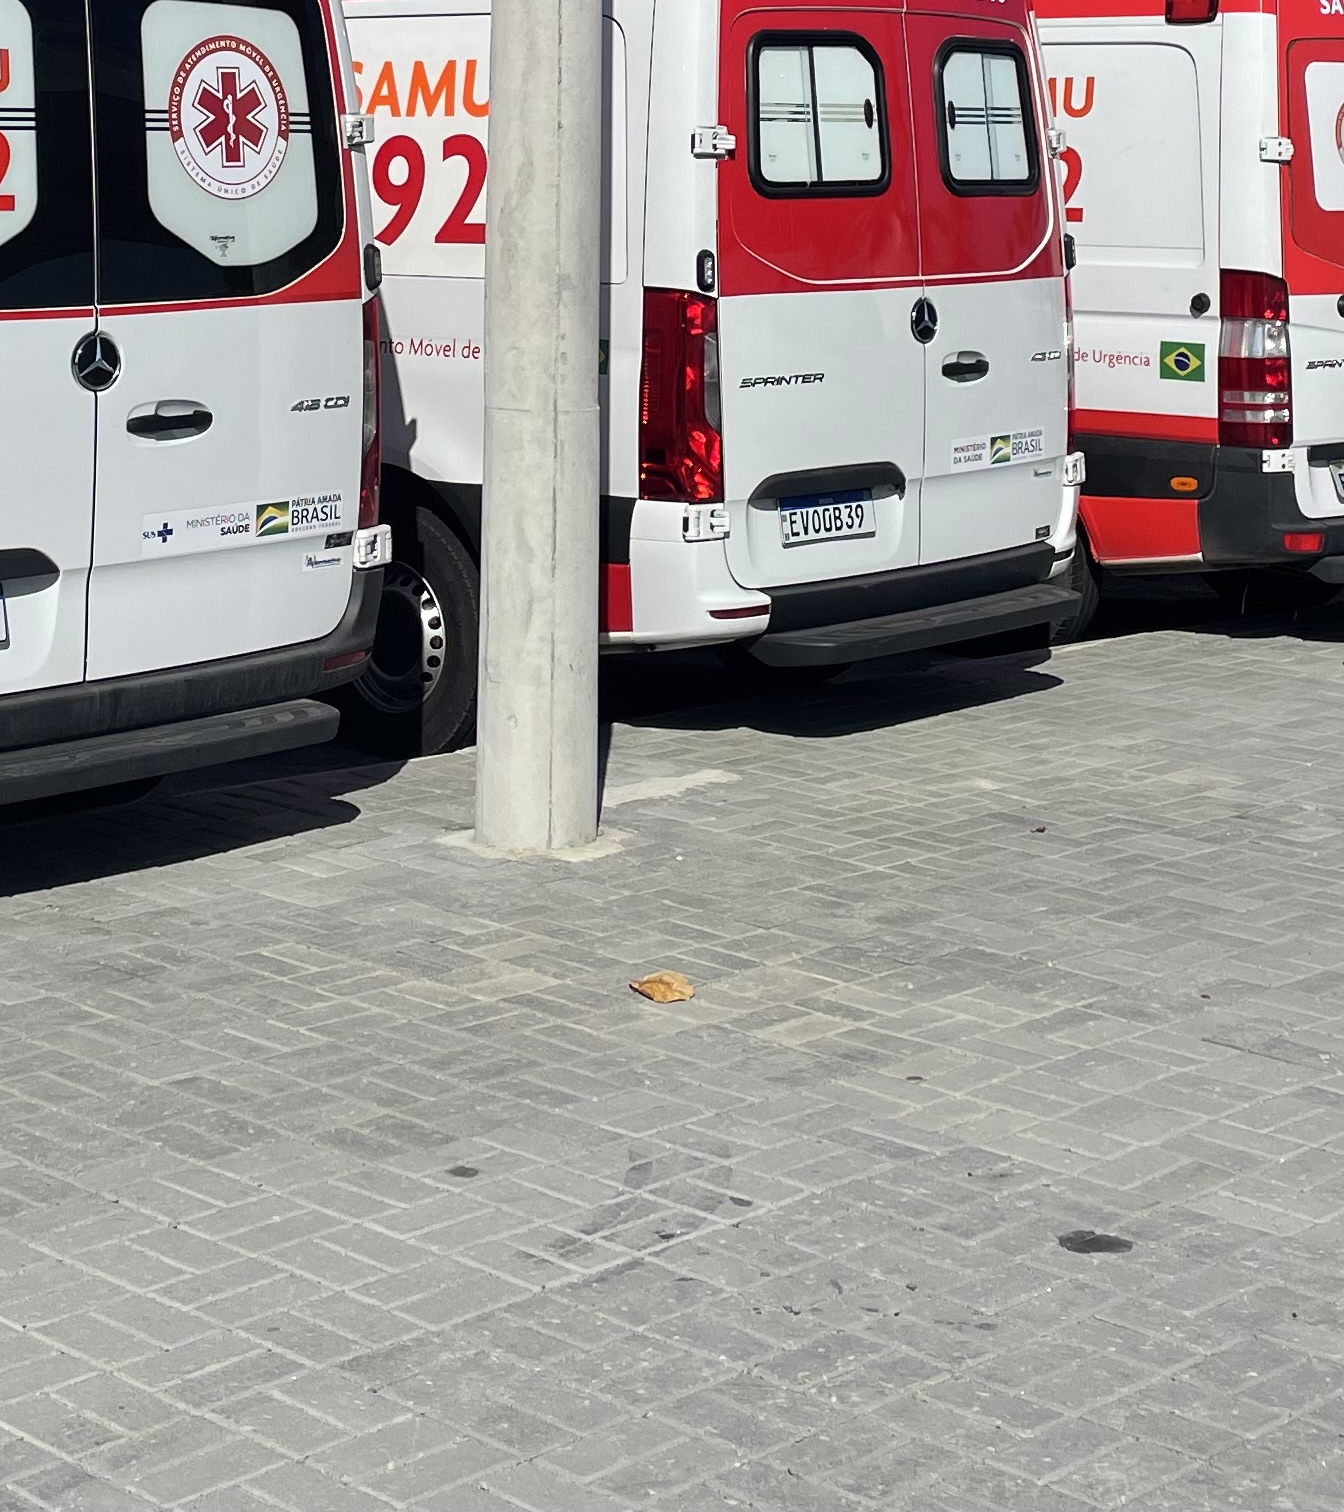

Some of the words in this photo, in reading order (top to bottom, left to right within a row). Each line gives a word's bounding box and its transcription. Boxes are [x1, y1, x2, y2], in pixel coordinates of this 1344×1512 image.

[184, 40, 237, 71] ATENDIMENTO
[372, 134, 488, 246] 92
[409, 338, 456, 358] Móvel
[461, 339, 481, 359] de
[1073, 347, 1089, 362] de
[1092, 348, 1151, 368] Urgência
[739, 372, 825, 389] SPRINTER
[1012, 439, 1043, 456] BRASIL
[291, 497, 316, 509] PÁTRIA
[317, 493, 342, 504] AMADA
[186, 513, 237, 529] MINISTÉRIO
[238, 512, 251, 522] DA
[291, 504, 341, 526] BRASIL
[220, 523, 251, 536] SAÚDE
